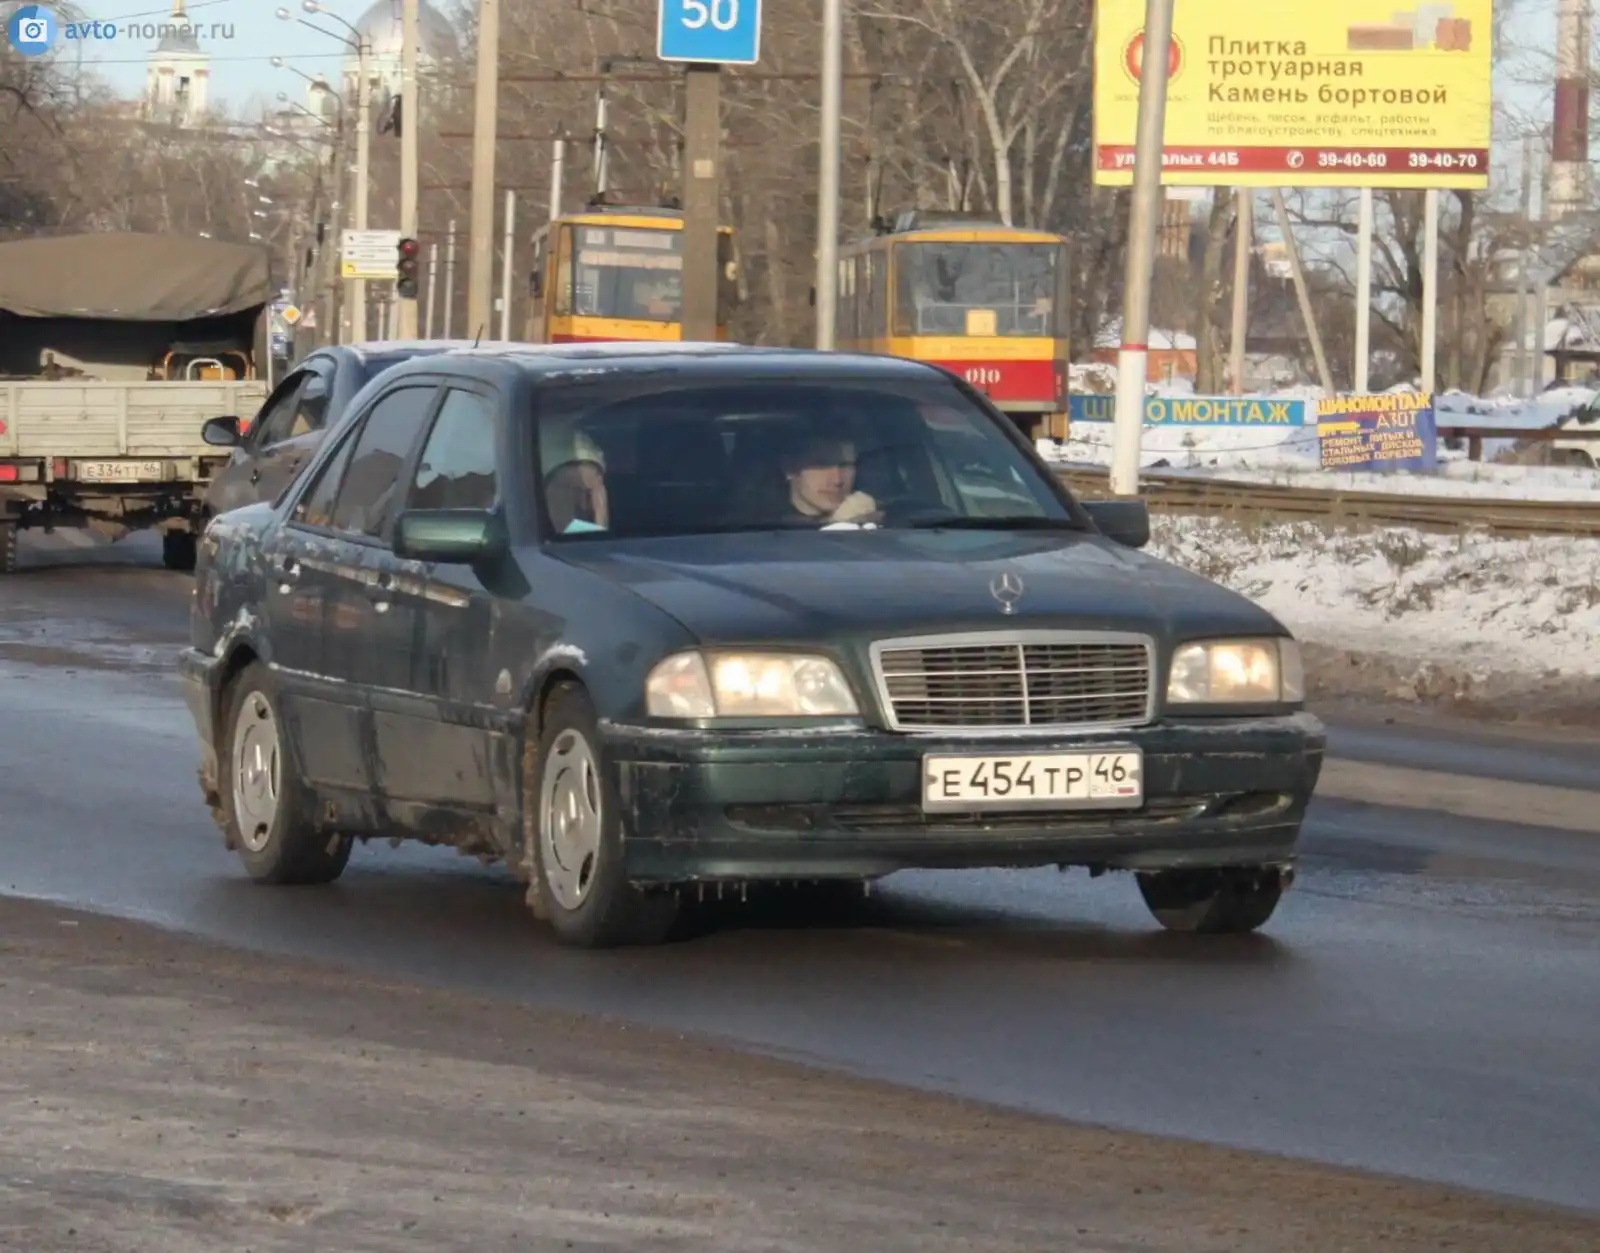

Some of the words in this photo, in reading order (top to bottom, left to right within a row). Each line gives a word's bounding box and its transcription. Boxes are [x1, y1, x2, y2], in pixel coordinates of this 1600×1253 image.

[681, 0, 738, 30] 50
[1208, 35, 1306, 55] Плитка
[1207, 60, 1363, 80] тротуарная
[1208, 82, 1309, 103] Камень
[1318, 84, 1447, 107] бортовой
[1380, 114, 1430, 126] работы
[1207, 126, 1223, 135] по
[1351, 127, 1437, 137] спецтехника
[1161, 154, 1204, 166] алых
[1208, 151, 1239, 166] 44Б
[1318, 152, 1387, 167] 39-40-60
[1408, 153, 1477, 168] 39-40-70
[1317, 391, 1431, 415] ШИНОМОНТАЖ
[1376, 410, 1417, 429] АЗОТ
[1322, 435, 1363, 448] РЕМОНТ
[943, 760, 1083, 797] Е454ТР
[1094, 755, 1127, 783] 46
